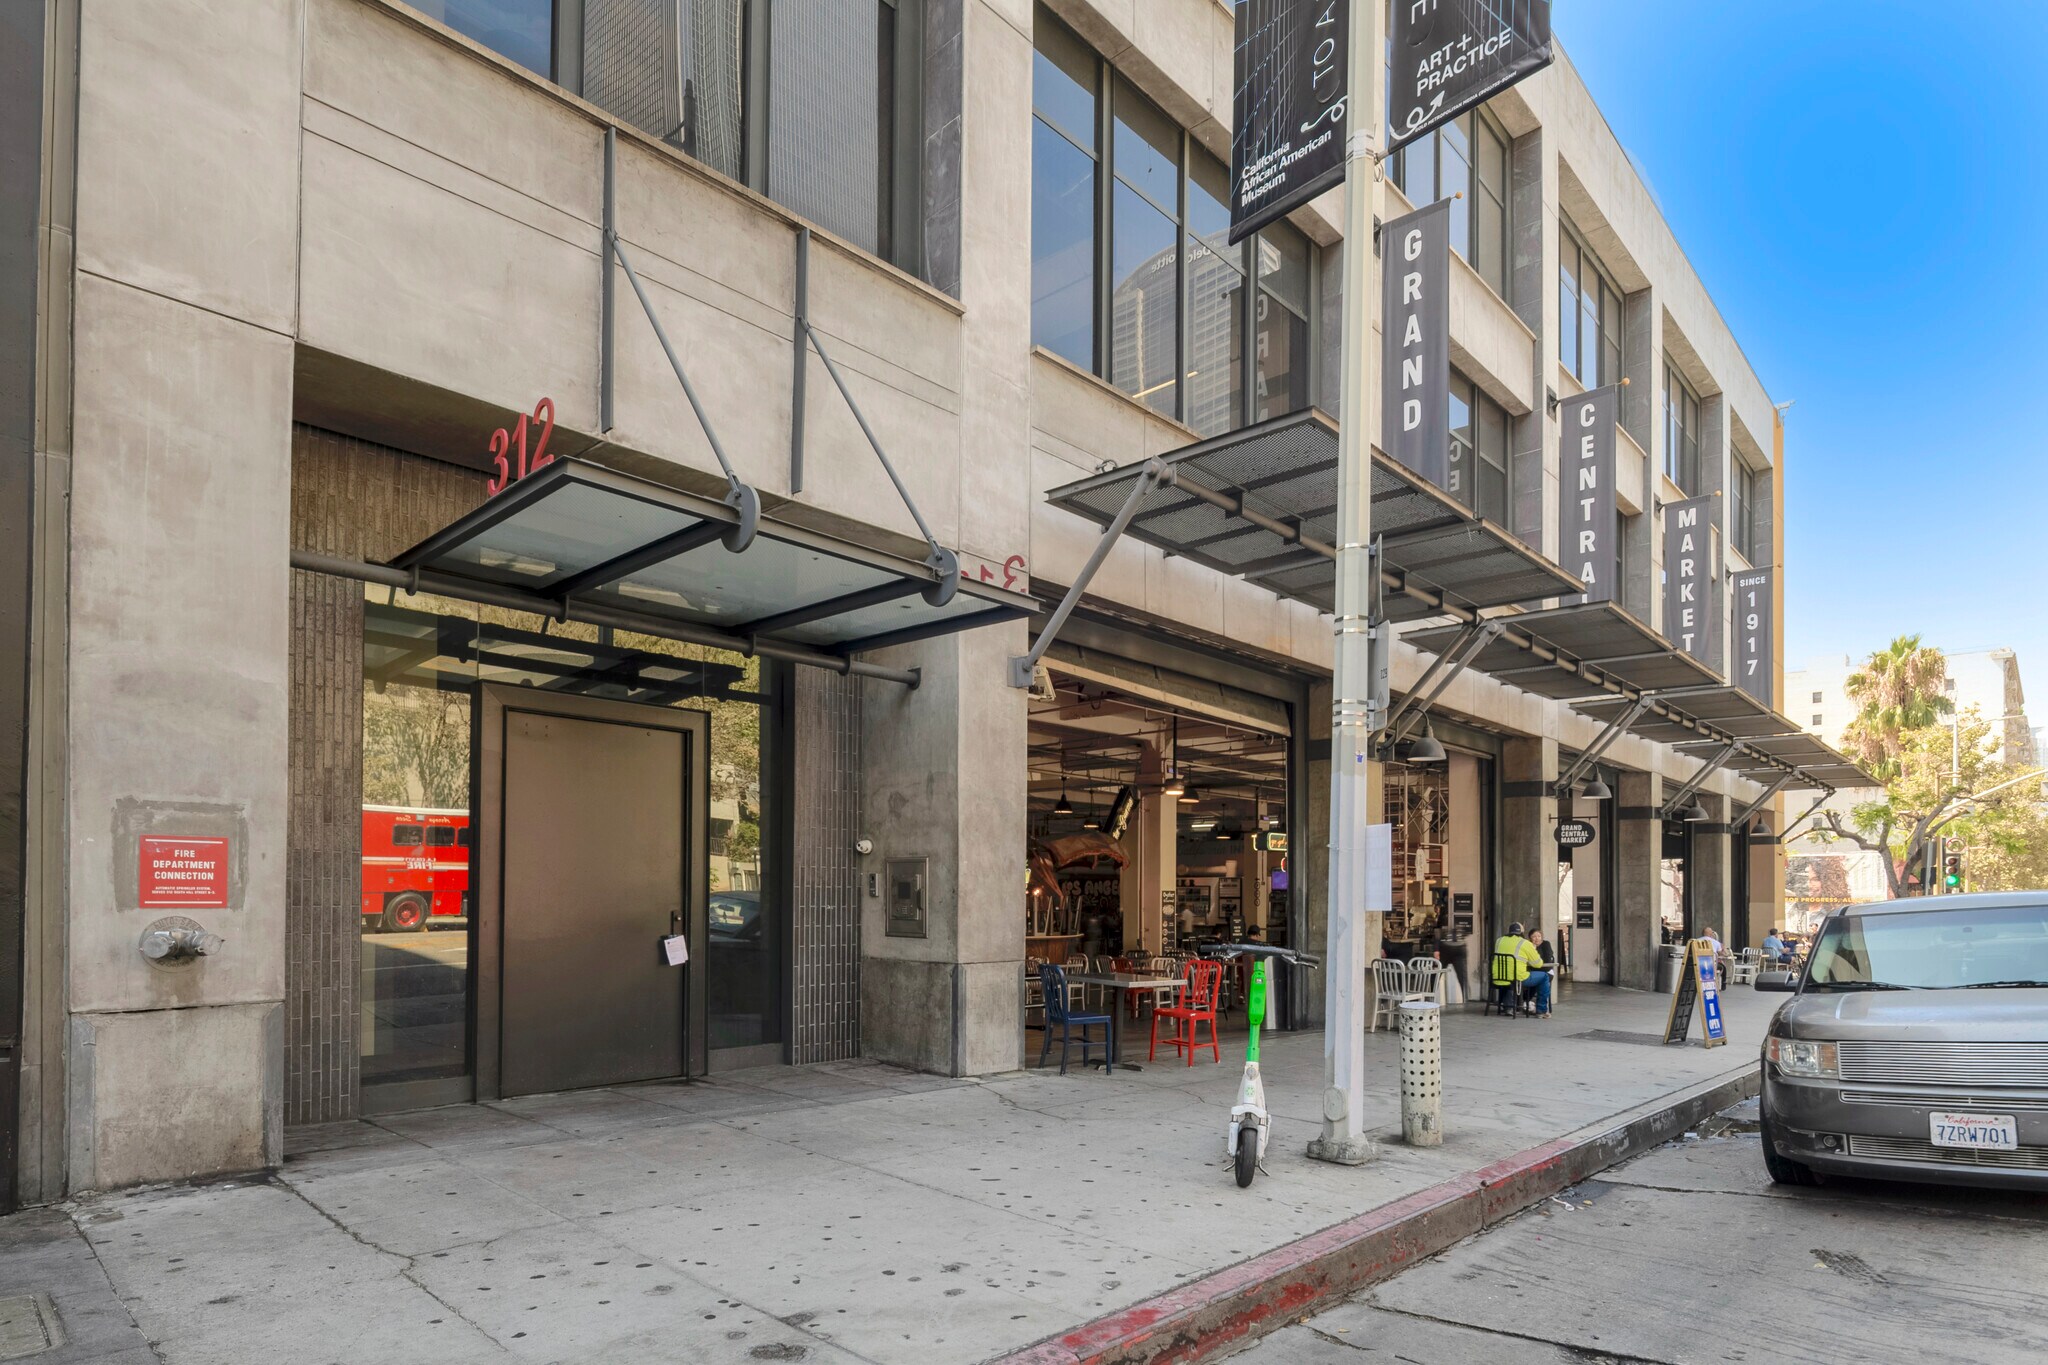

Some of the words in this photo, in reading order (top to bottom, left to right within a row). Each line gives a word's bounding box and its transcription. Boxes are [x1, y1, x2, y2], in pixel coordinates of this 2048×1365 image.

[1416, 41, 1455, 78] ART
[1416, 26, 1512, 98] PRACTICE
[1241, 163, 1277, 194] African
[1279, 130, 1332, 170] American
[1242, 142, 1290, 179] California
[1241, 172, 1286, 207] Museum
[1402, 228, 1423, 433] GRAND
[486, 396, 555, 497] 312
[1678, 507, 1697, 652] MARKET
[1739, 576, 1766, 588] SINCE
[1746, 591, 1759, 676] 1917
[152, 860, 216, 869] DEPARTMENT
[174, 849, 195, 858] FIRE
[154, 871, 214, 880] CONNECTION
[1708, 1018, 1720, 1031] OPEN
[1936, 1125, 2011, 1144] 7ZRW701
[1947, 1114, 1995, 1126] California
